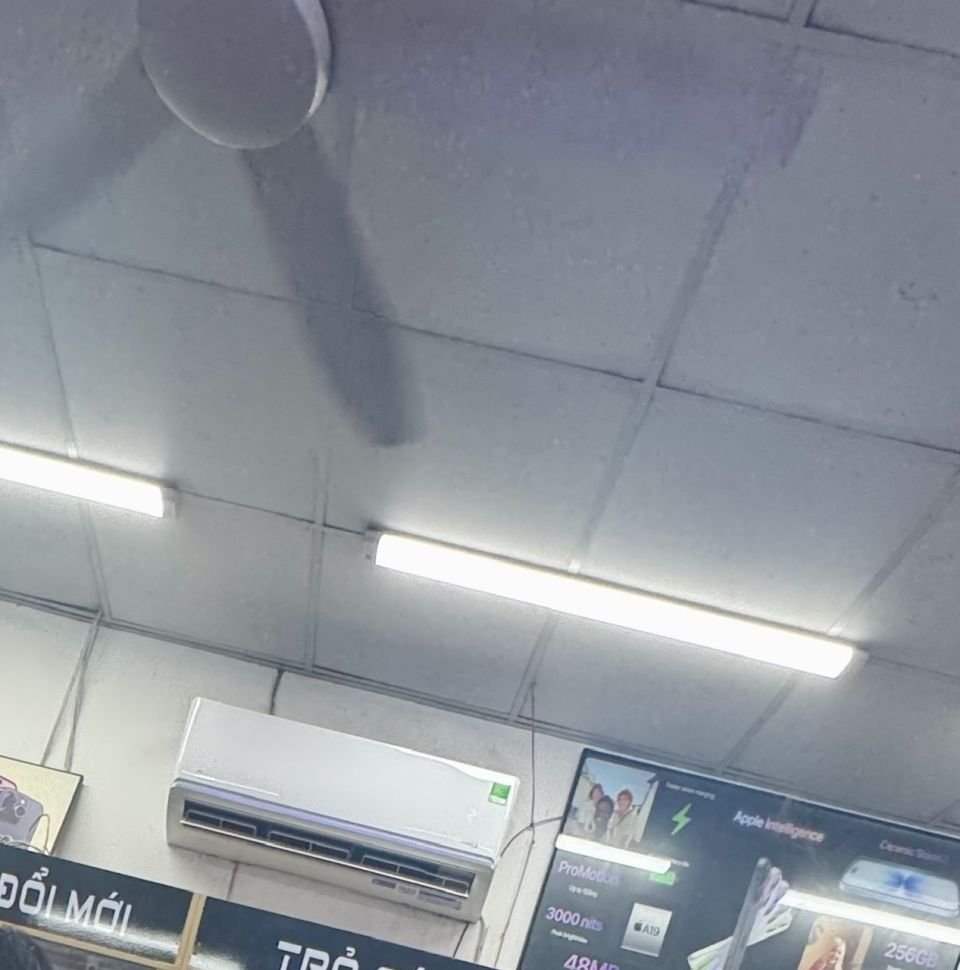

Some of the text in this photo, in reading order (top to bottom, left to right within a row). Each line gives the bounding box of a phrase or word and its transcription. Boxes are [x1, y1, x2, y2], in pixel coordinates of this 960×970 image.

[732, 810, 825, 842] Apple Intelligence
[64, 890, 133, 937] MỚI
[545, 906, 580, 927] 3000
[641, 924, 660, 937] A19
[884, 942, 940, 968] 256GB
